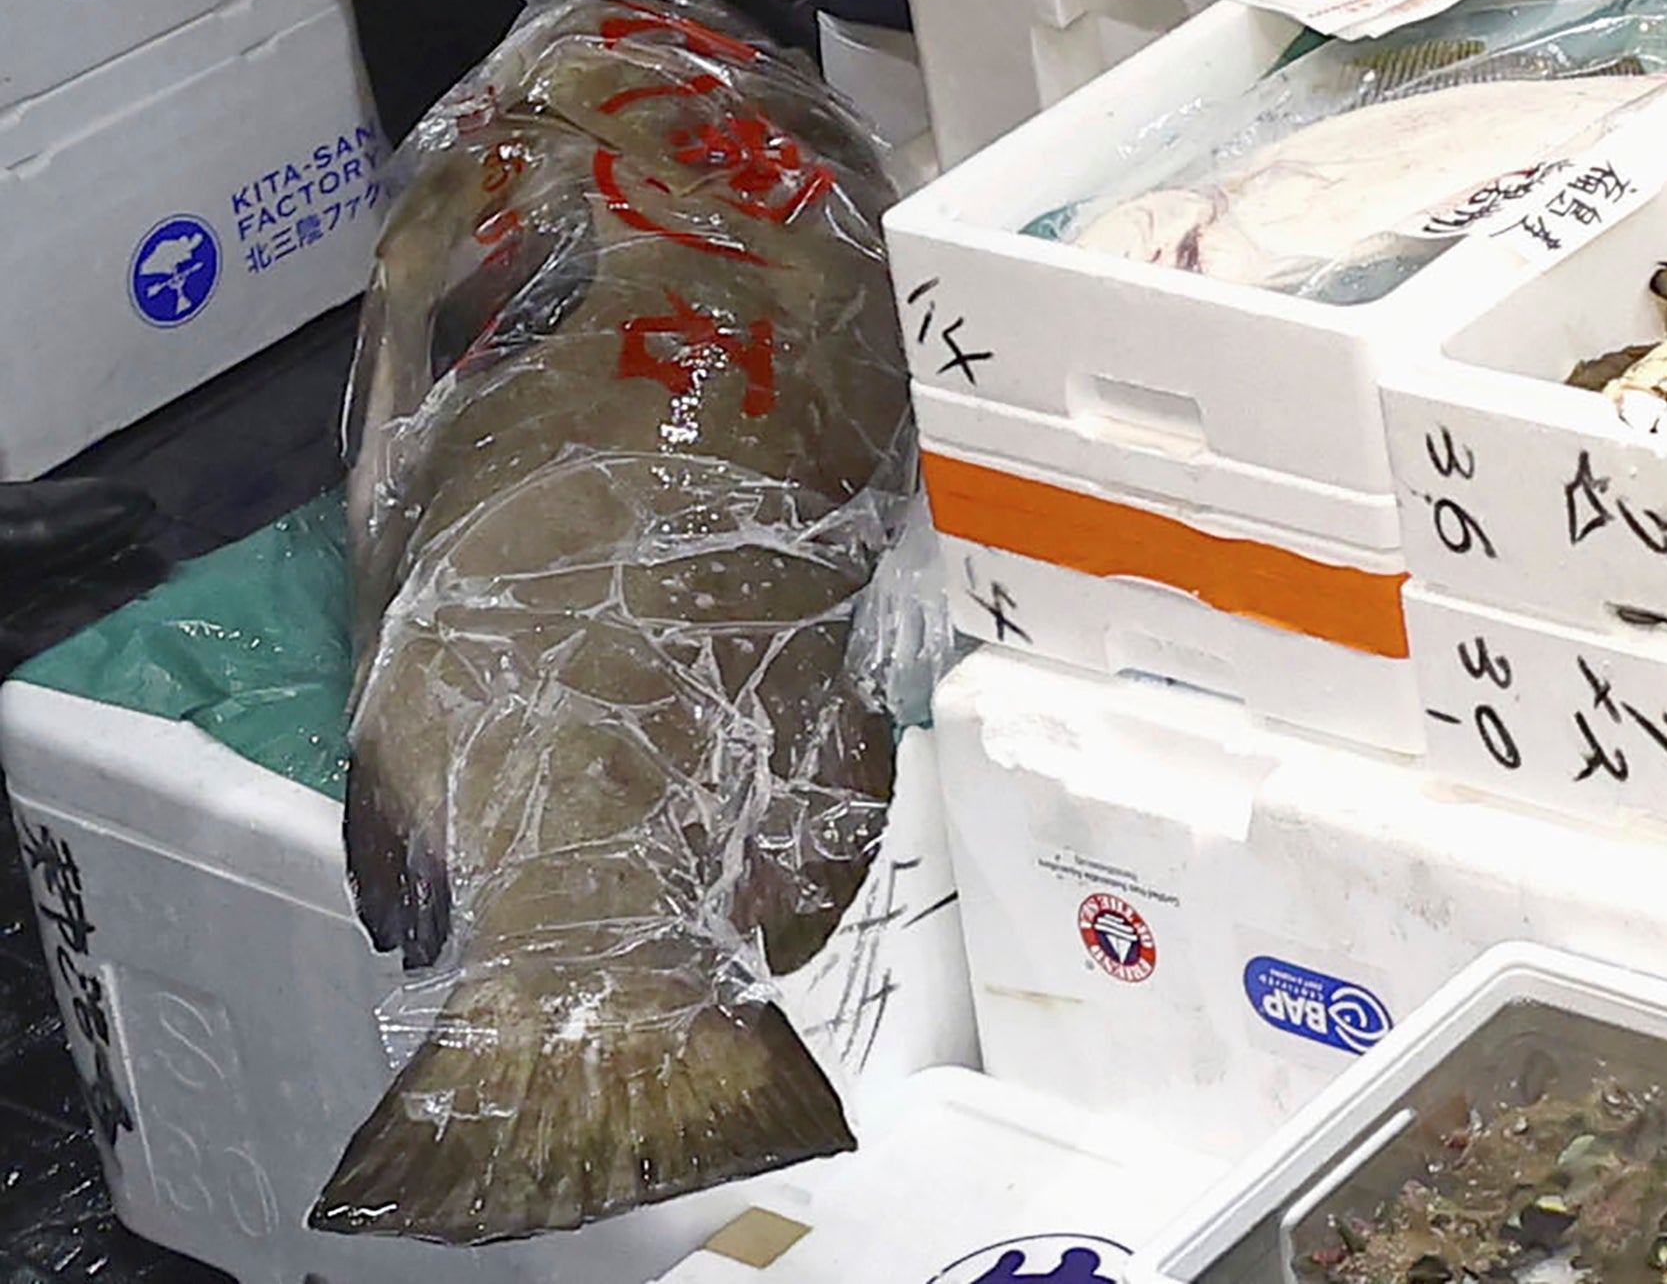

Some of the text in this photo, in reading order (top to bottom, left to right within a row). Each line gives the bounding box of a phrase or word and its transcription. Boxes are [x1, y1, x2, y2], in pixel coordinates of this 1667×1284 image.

[237, 150, 382, 242] FACTORY
[1490, 159, 1635, 251] 福島産
[1096, 894, 1135, 921] THE
[1133, 918, 1154, 948] OF
[1089, 944, 1153, 981] FRIEND
[1261, 988, 1328, 1034] BAP
